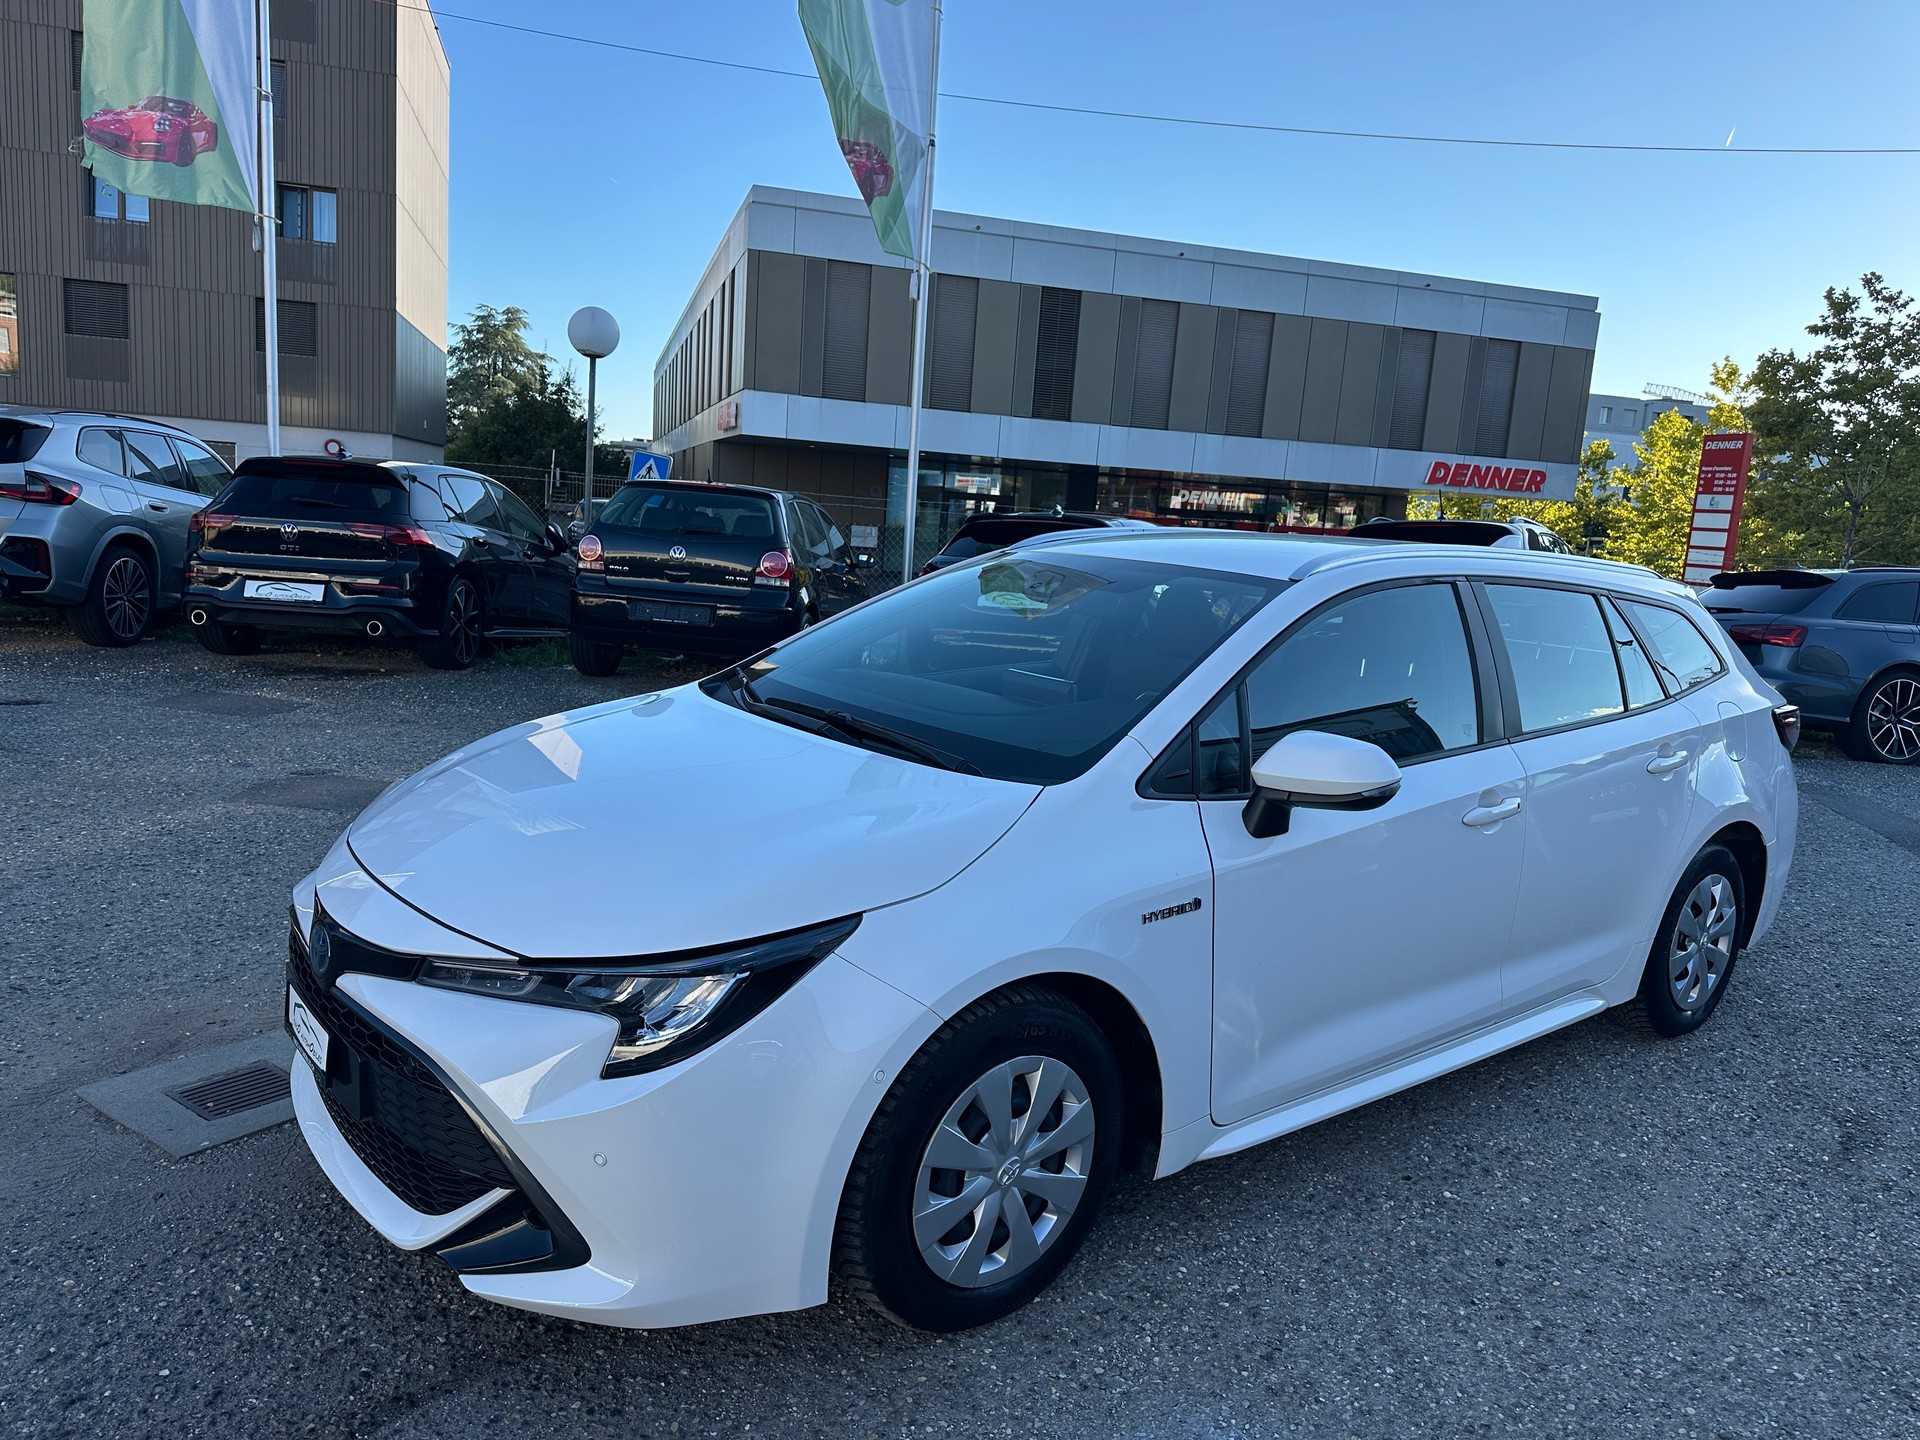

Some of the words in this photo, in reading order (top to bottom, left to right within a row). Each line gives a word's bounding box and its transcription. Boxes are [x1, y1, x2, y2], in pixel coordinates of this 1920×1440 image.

[1705, 440, 1744, 450] DENNER
[1423, 461, 1547, 493] DENNER
[279, 544, 300, 552] GTI
[1141, 901, 1193, 925] HYBRID
